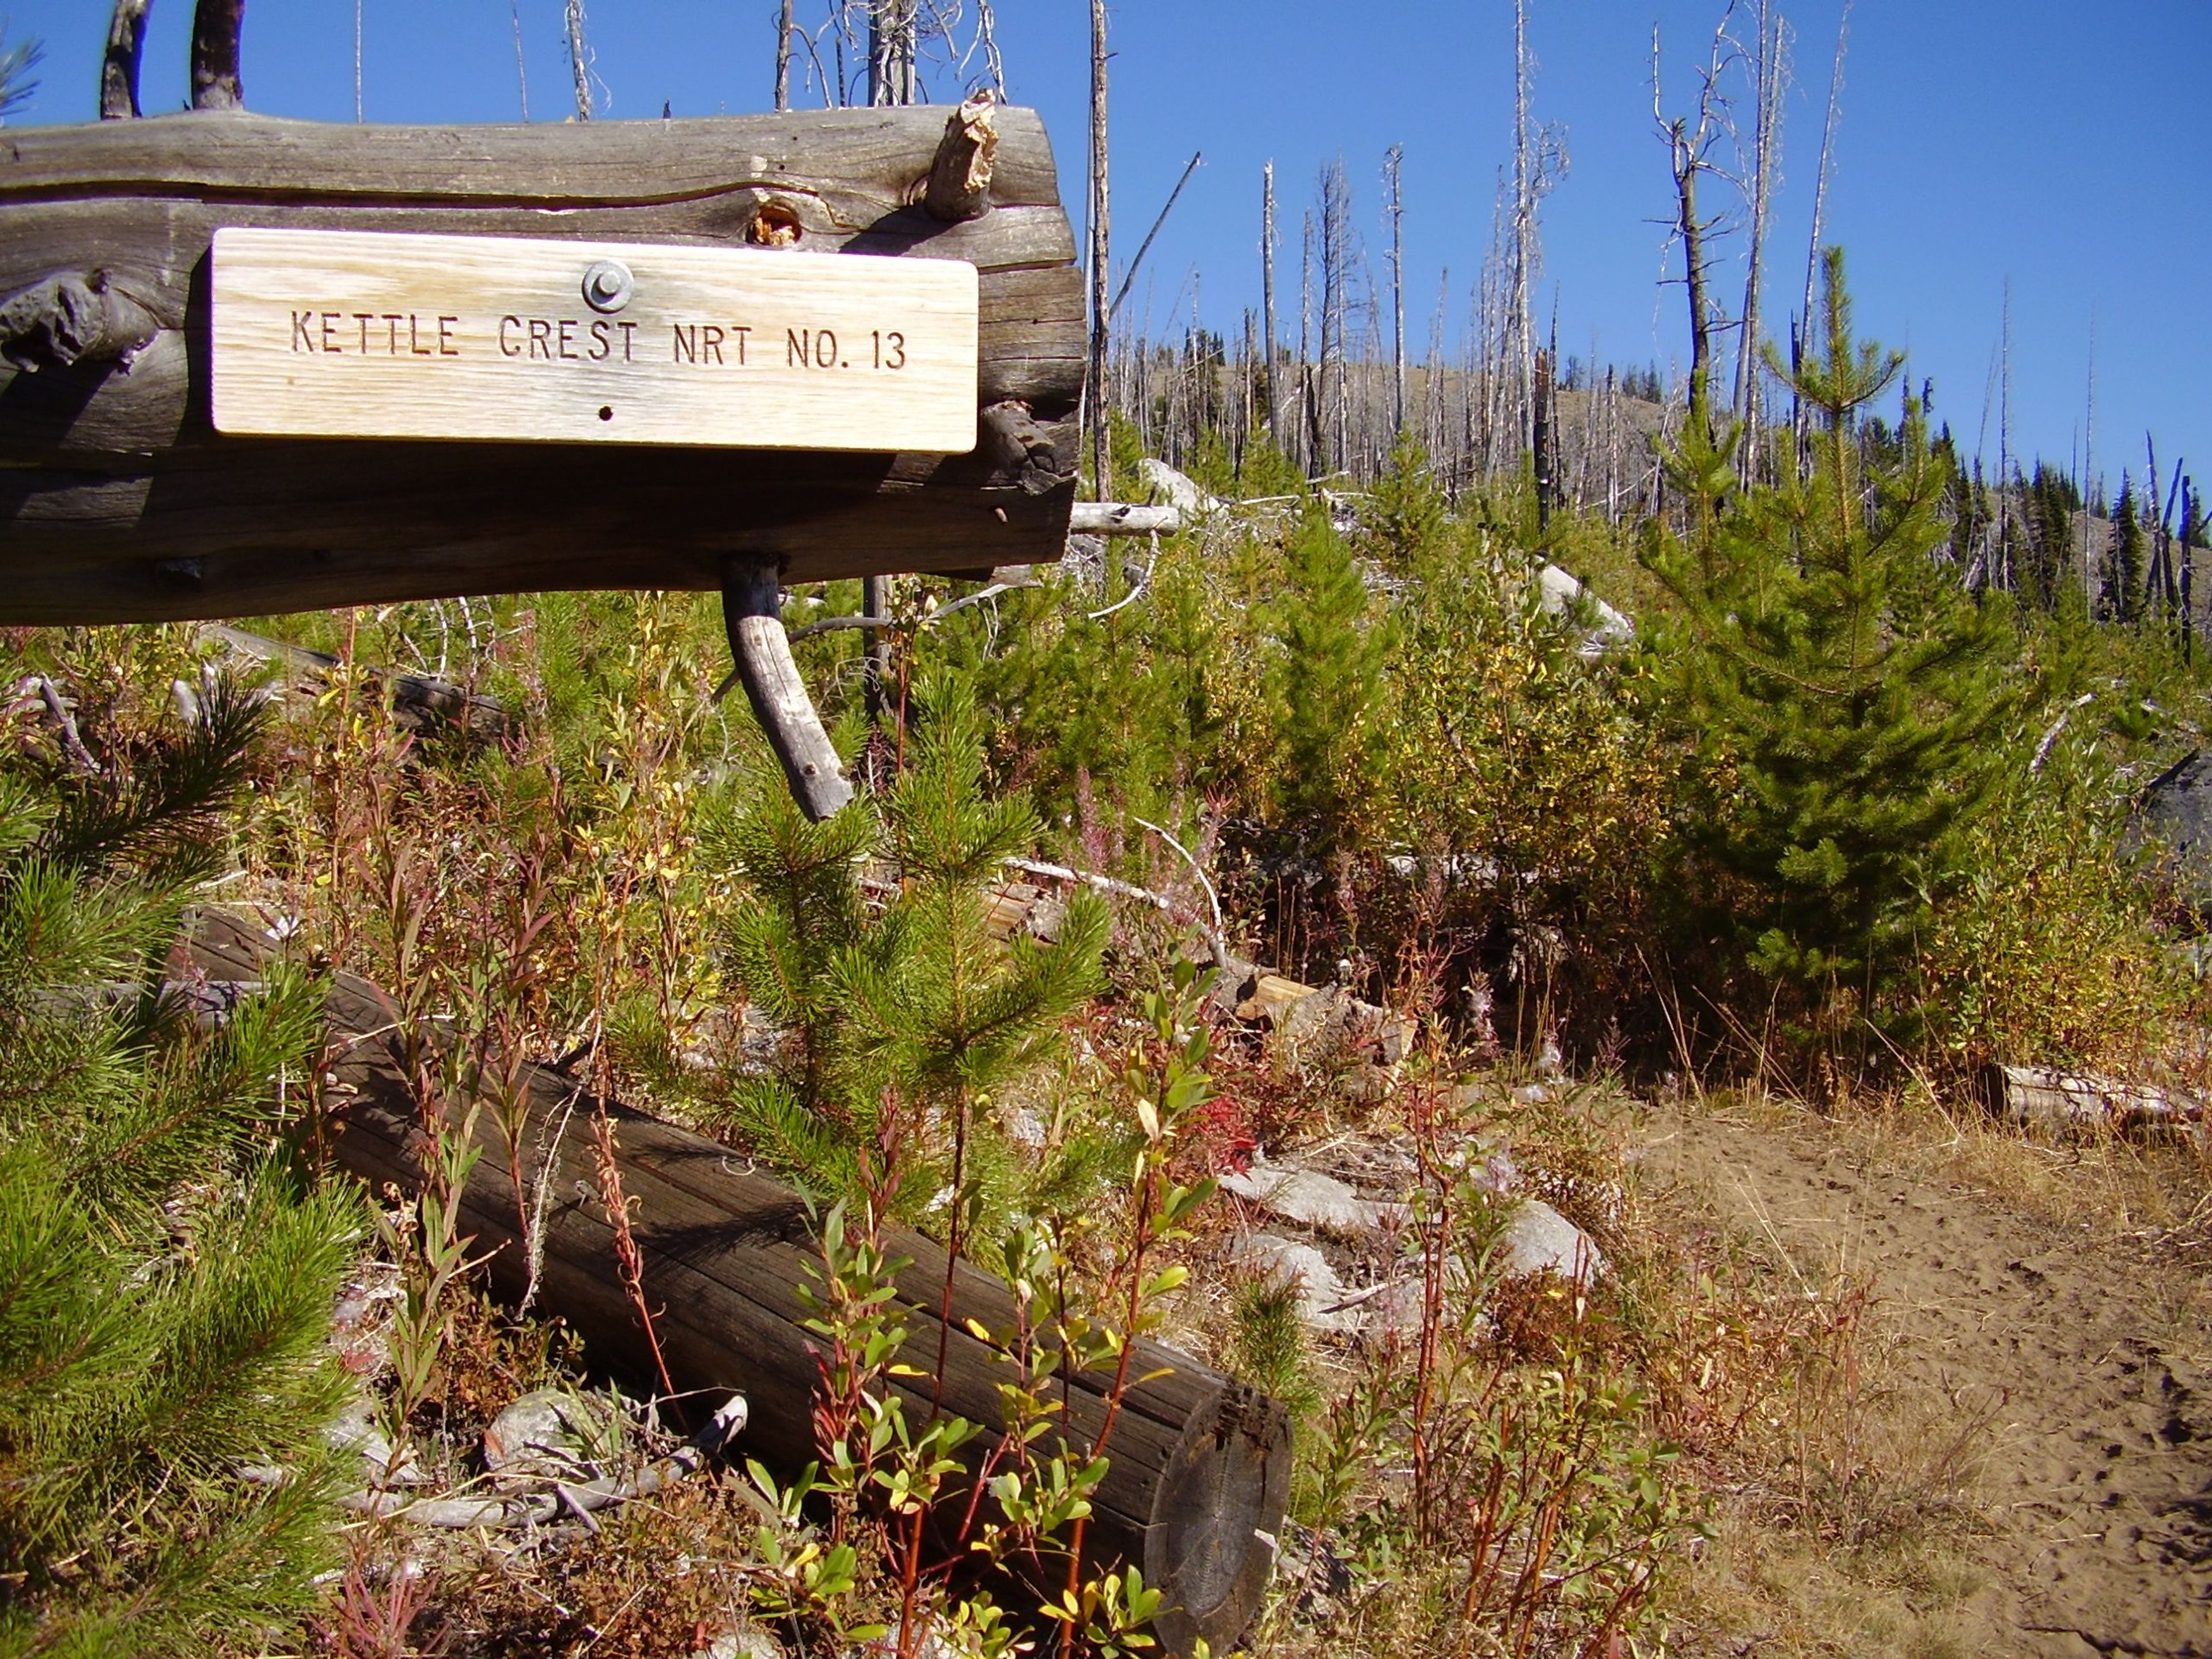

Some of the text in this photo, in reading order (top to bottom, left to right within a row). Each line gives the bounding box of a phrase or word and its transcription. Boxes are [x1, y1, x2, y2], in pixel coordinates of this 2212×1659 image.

[291, 310, 906, 370] KETTLE CREST NRT NO. 13
